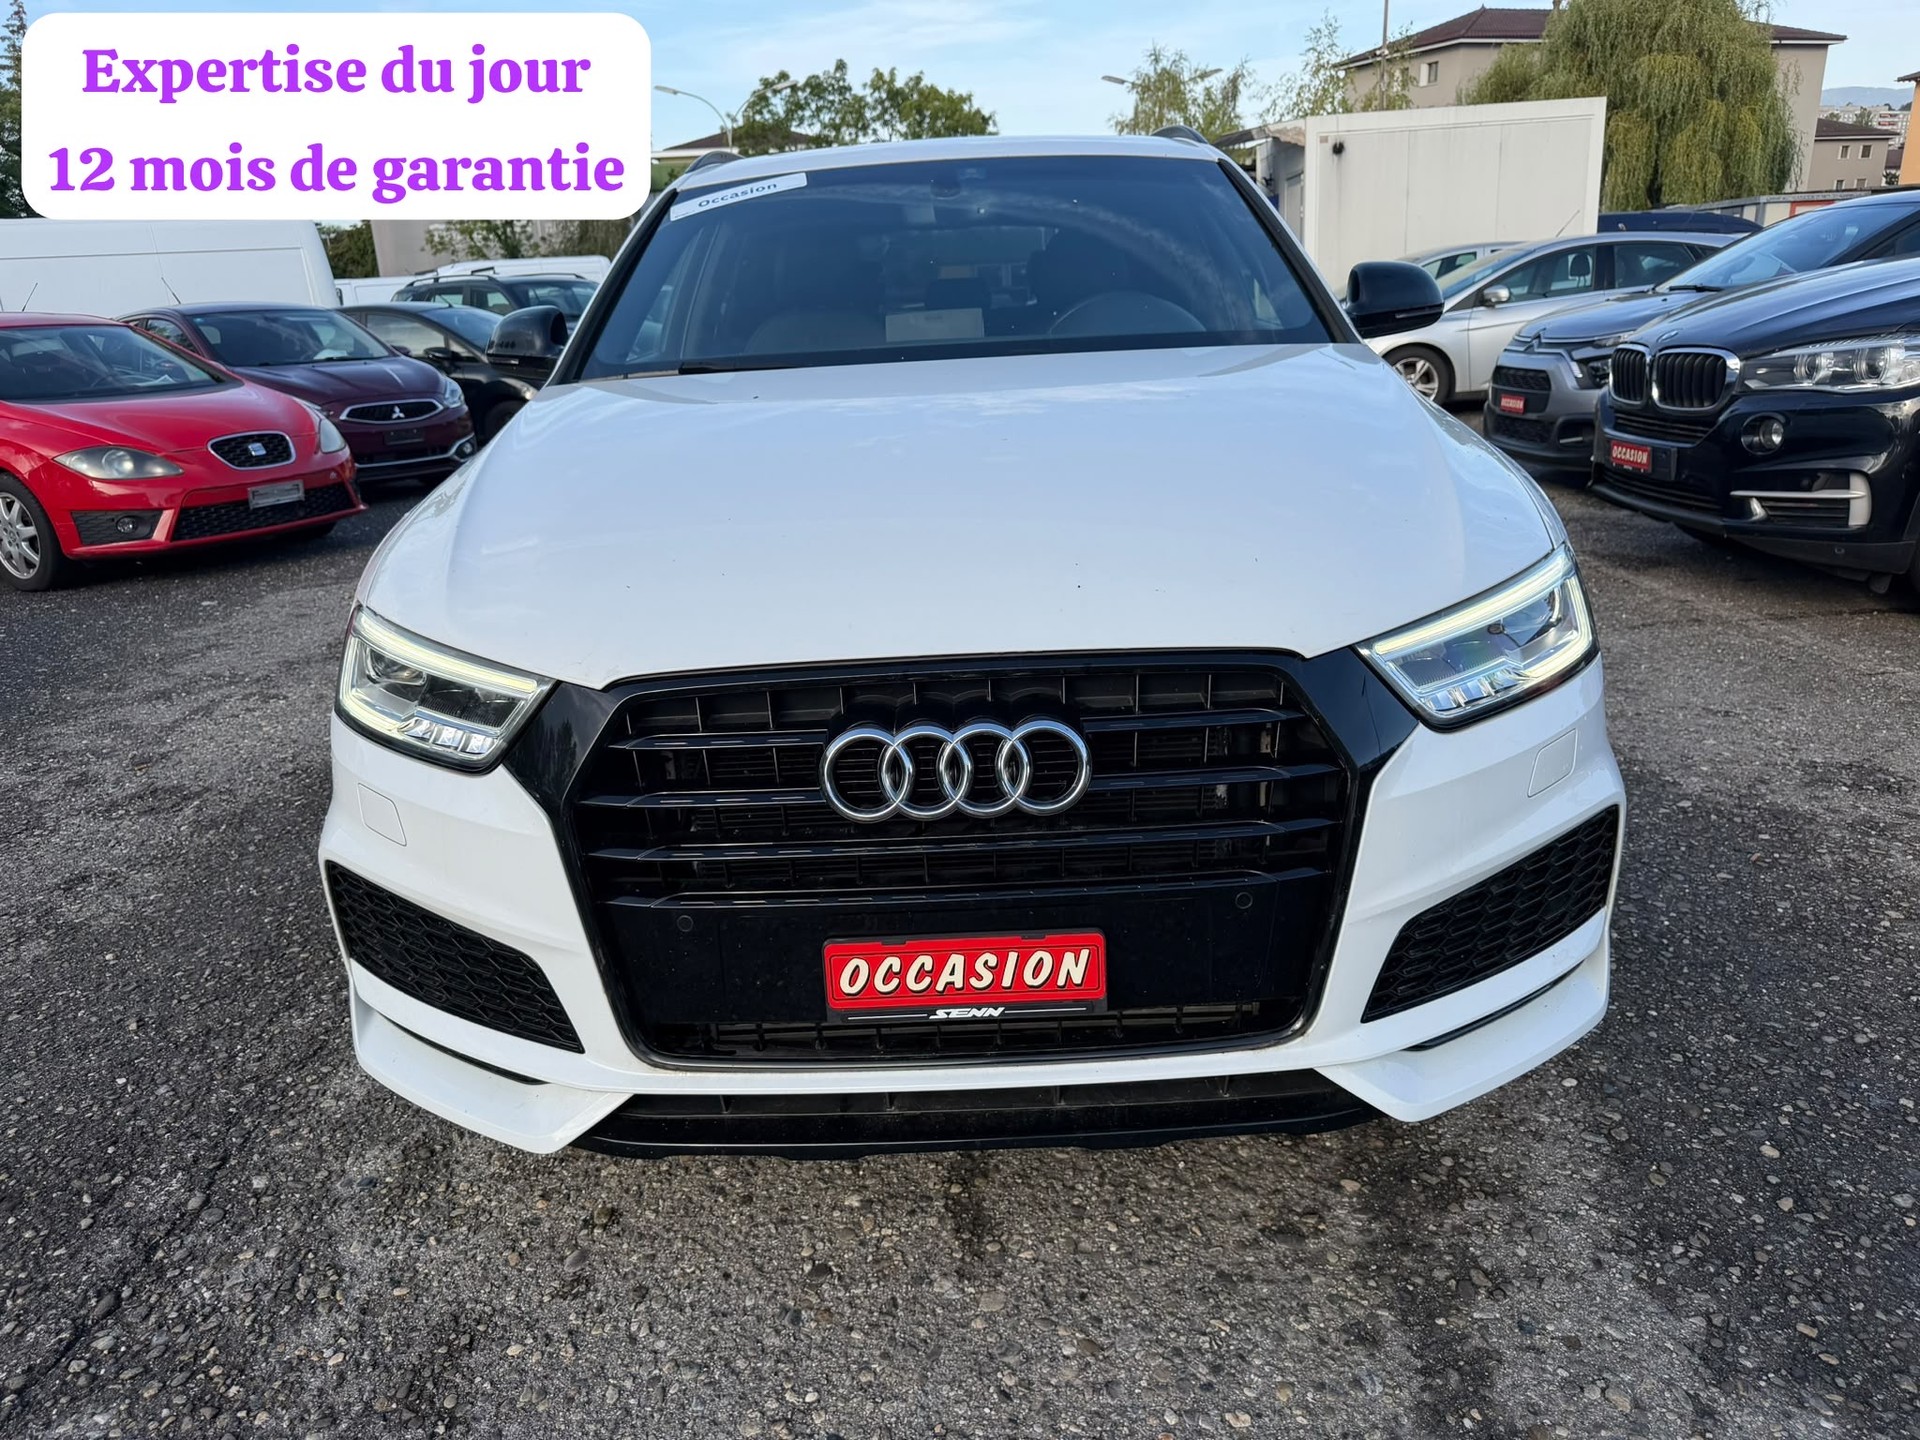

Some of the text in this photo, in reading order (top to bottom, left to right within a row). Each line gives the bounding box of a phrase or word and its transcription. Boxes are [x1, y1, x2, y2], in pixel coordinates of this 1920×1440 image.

[698, 183, 777, 208] Occasion
[1612, 445, 1648, 464] OCCASION
[839, 948, 1090, 995] OCCASION
[929, 1007, 1005, 1019] SENN
